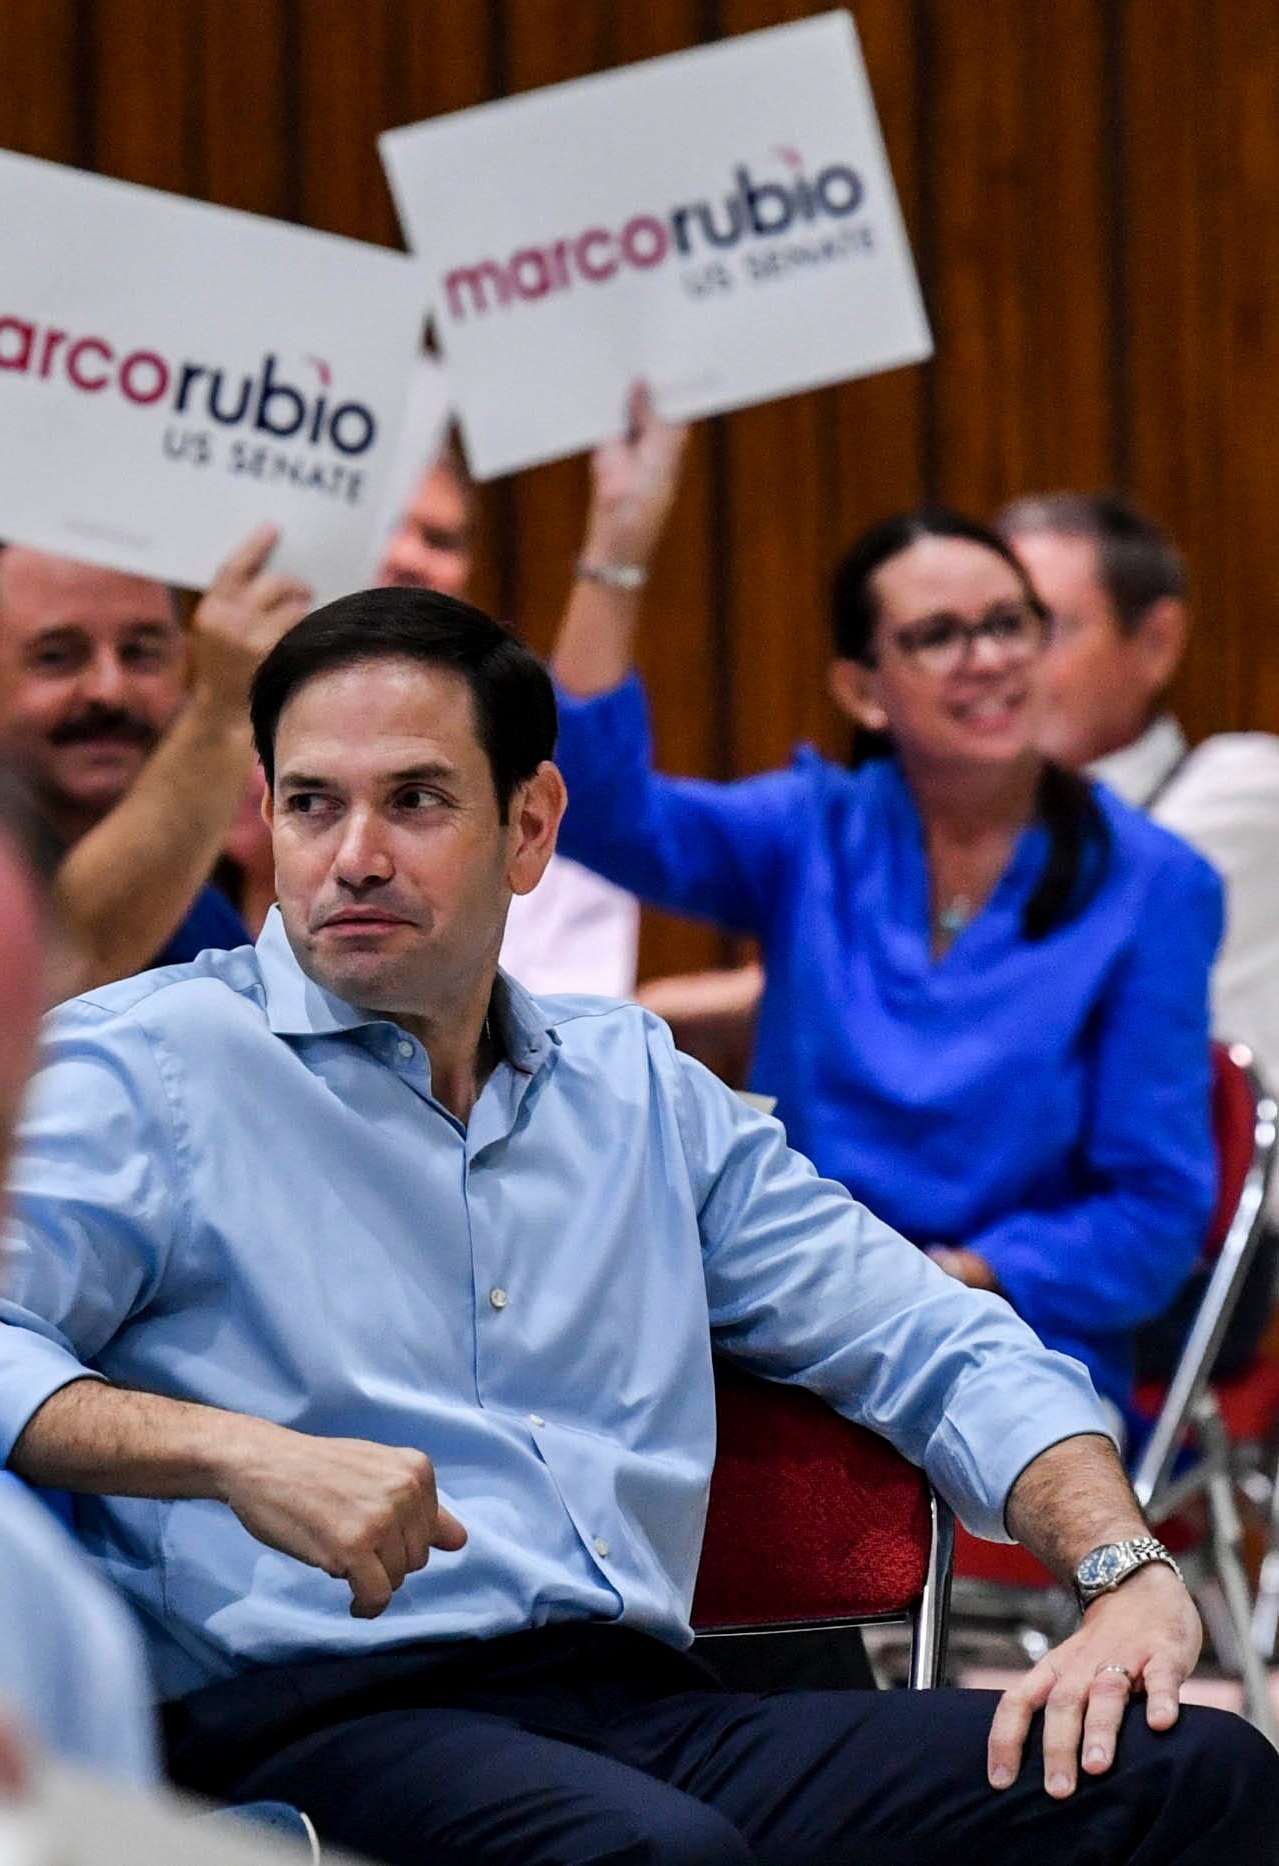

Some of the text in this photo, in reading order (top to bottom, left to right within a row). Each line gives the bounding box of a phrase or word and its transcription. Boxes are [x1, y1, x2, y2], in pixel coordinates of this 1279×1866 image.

[444, 146, 865, 319] marcorubio
[162, 426, 368, 505] US SENATE
